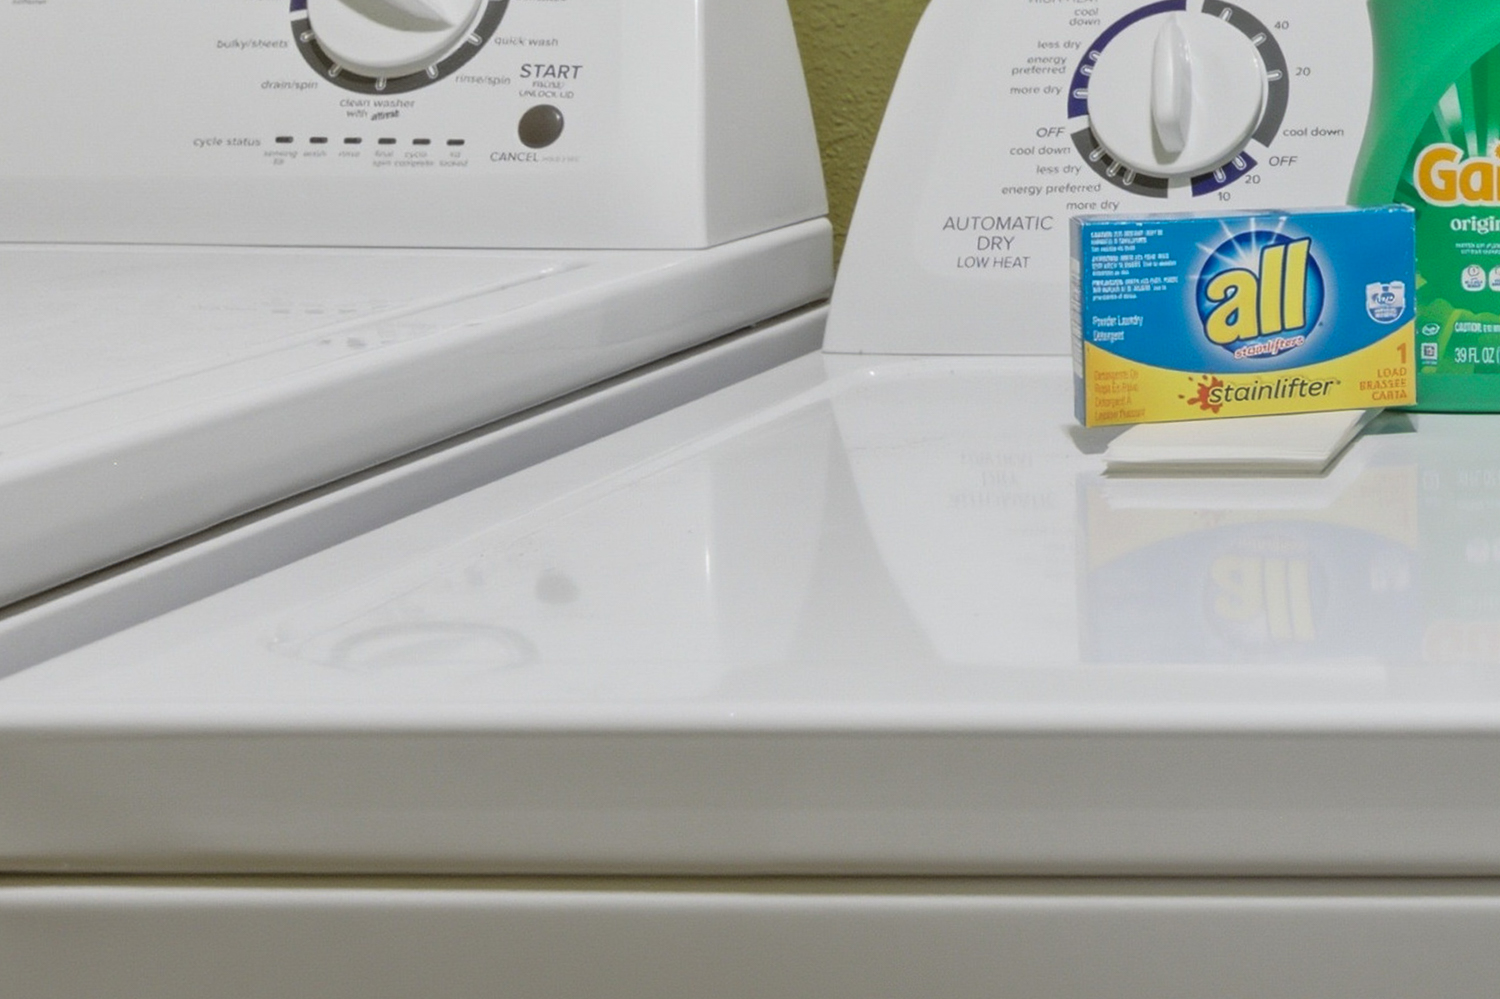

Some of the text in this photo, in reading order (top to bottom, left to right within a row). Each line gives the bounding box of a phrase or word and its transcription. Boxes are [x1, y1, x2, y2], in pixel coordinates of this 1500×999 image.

[1074, 7, 1099, 17] cool
[1069, 16, 1101, 26] down
[1274, 20, 1290, 30] 40
[216, 37, 289, 51] bulky/sheets
[493, 35, 559, 49] quick wash
[1037, 39, 1082, 52] less dry
[1026, 56, 1067, 68] energy
[520, 63, 583, 80] START
[1011, 64, 1067, 77] preferred
[1295, 66, 1312, 77] 20
[260, 79, 319, 92] drain/spin
[454, 73, 512, 87] rinse/spin
[1010, 84, 1063, 97] more dry
[373, 98, 415, 109] washer
[1036, 127, 1065, 138] OFF
[1283, 127, 1344, 137] cool down
[193, 137, 262, 149] cycle status
[489, 151, 539, 163] CANCEL
[1010, 145, 1071, 156] cool down
[1268, 155, 1298, 167] OFF
[1036, 163, 1082, 177] less dry
[1244, 174, 1261, 184] 20
[1001, 182, 1102, 197] energy preferred
[1218, 191, 1231, 202] 10
[1066, 199, 1120, 213] more dry
[942, 216, 1054, 231] AUTOMATIC
[976, 236, 1015, 251] DRY
[956, 256, 1031, 269] LOW HEAT
[1204, 237, 1312, 345] all
[1396, 342, 1407, 364] 1
[1455, 347, 1467, 363] 39
[1468, 347, 1480, 363] FL
[1482, 347, 1495, 363] OZ
[1377, 367, 1407, 378] LOAD
[1208, 377, 1334, 404] stainlifter
